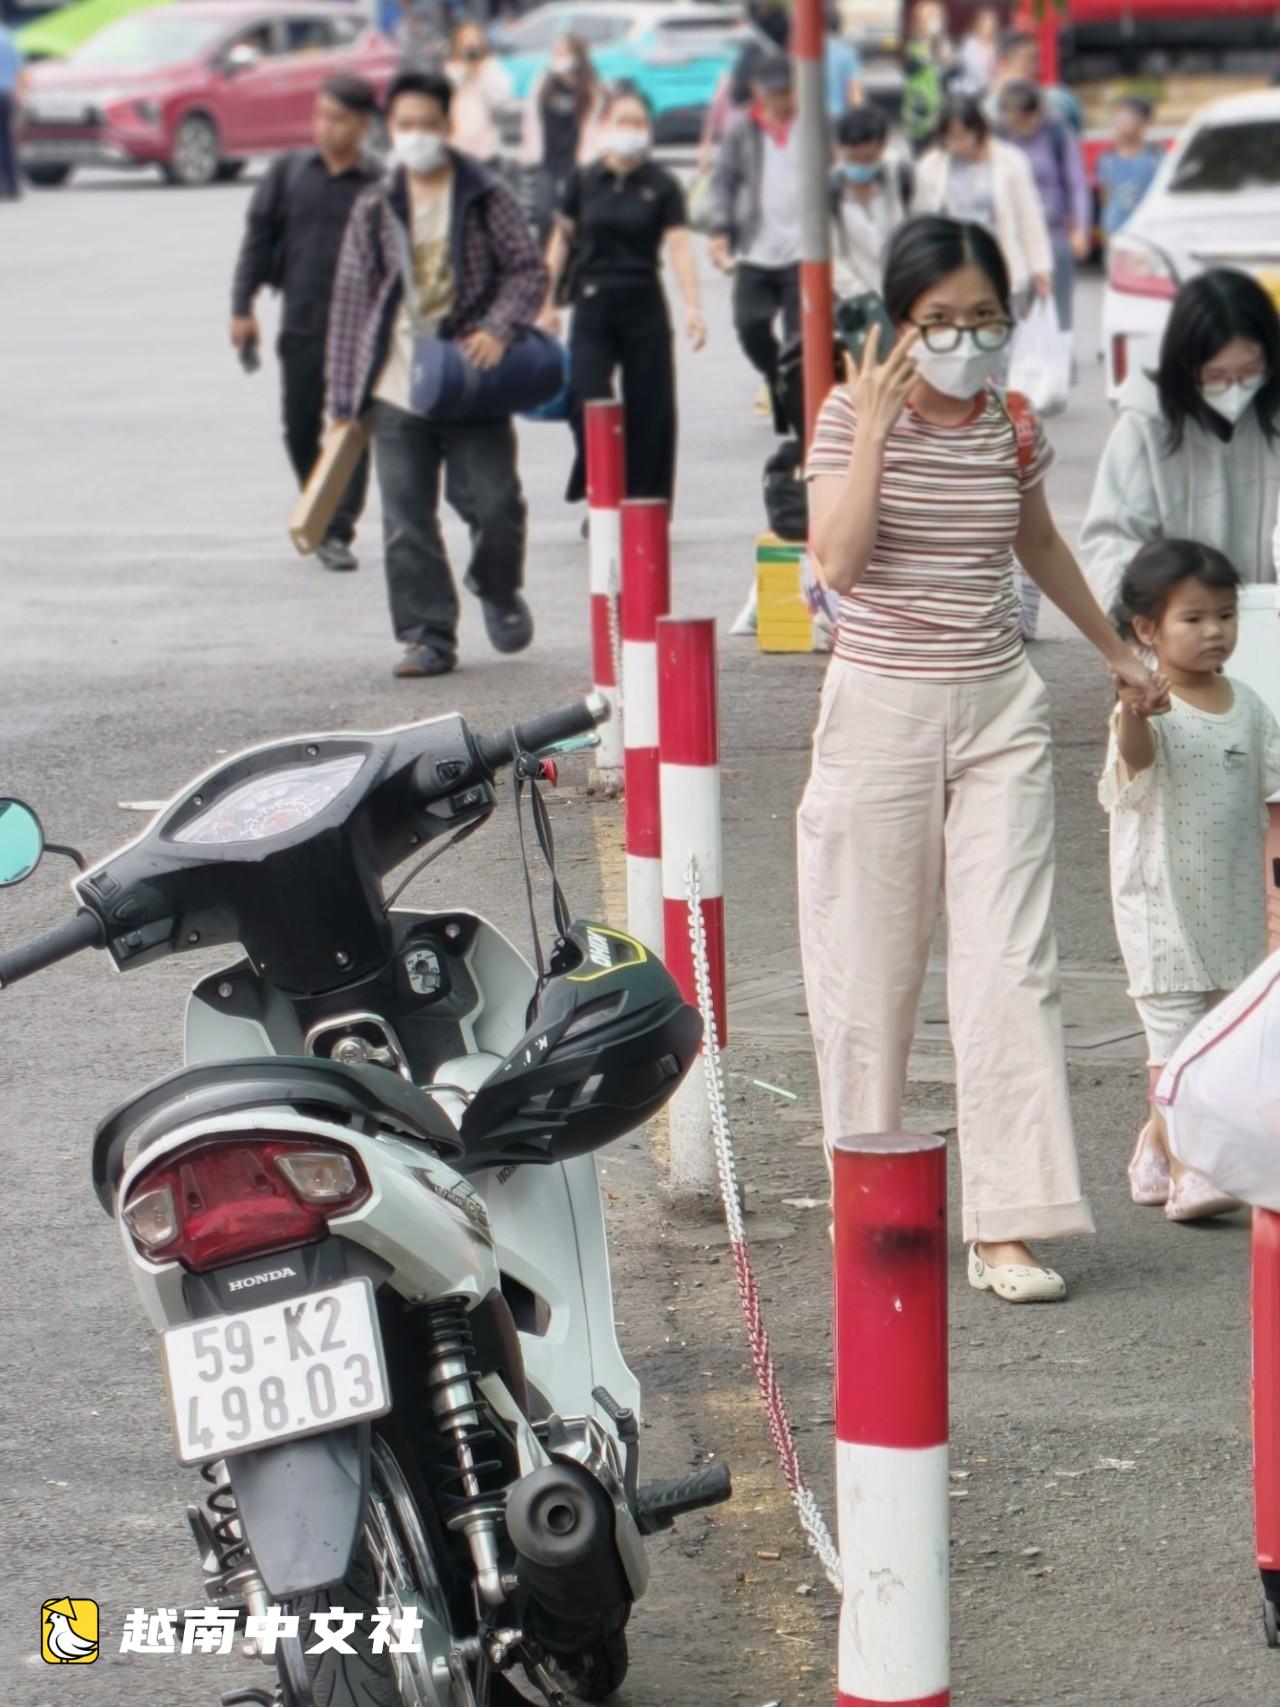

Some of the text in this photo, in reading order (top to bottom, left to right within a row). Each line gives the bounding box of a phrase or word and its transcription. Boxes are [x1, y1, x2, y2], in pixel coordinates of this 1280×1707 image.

[228, 1267, 296, 1292] HONDA
[192, 1296, 347, 1383] 59-K2
[188, 1353, 374, 1450] 498.03
